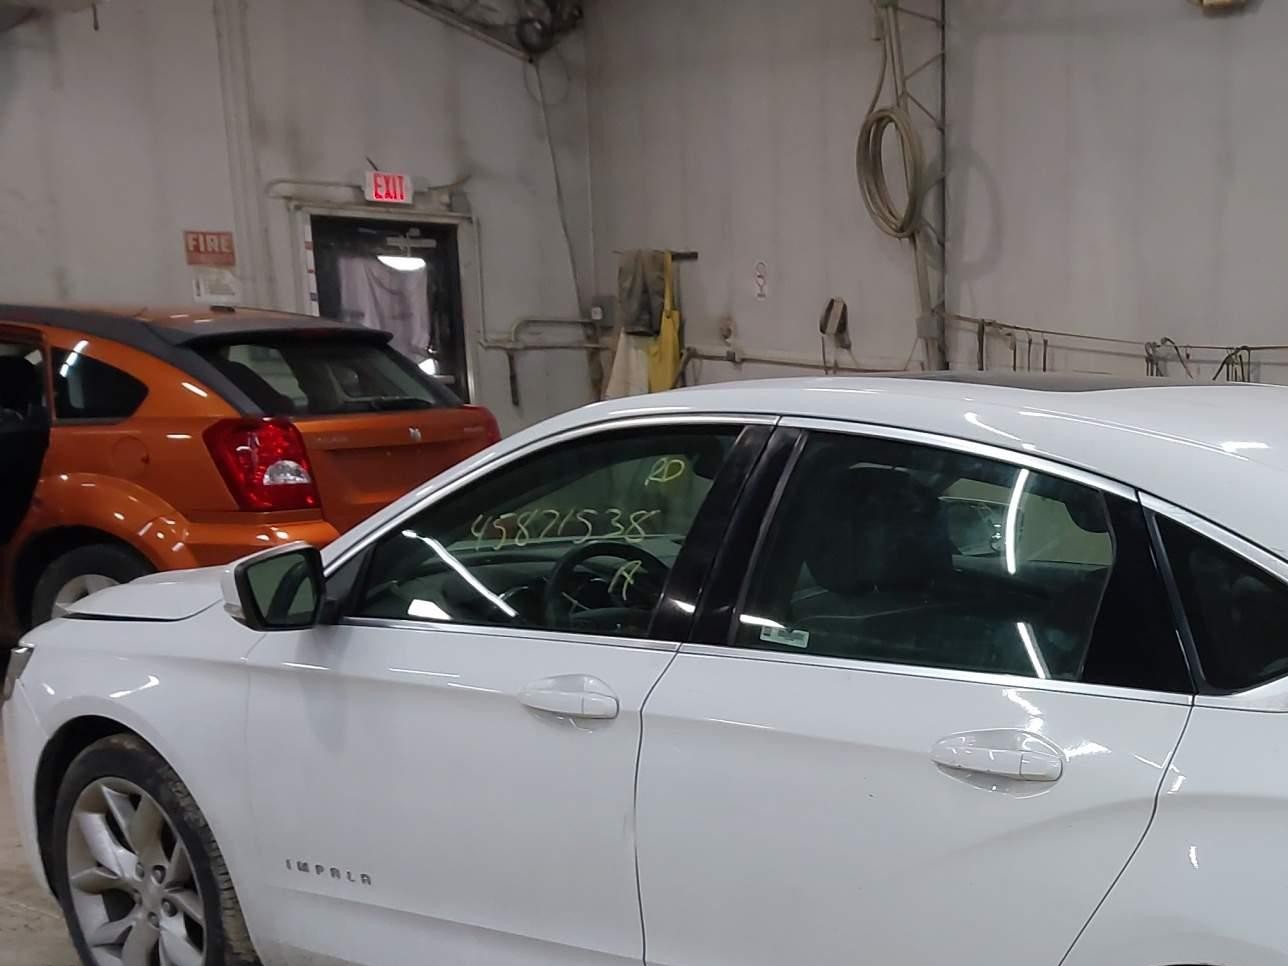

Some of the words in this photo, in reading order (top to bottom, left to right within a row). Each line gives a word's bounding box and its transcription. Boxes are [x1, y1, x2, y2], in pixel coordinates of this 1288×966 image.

[373, 172, 406, 200] EXIT
[187, 232, 233, 253] FIRE
[471, 508, 661, 551] 45871538
[285, 859, 372, 885] IMPALA
